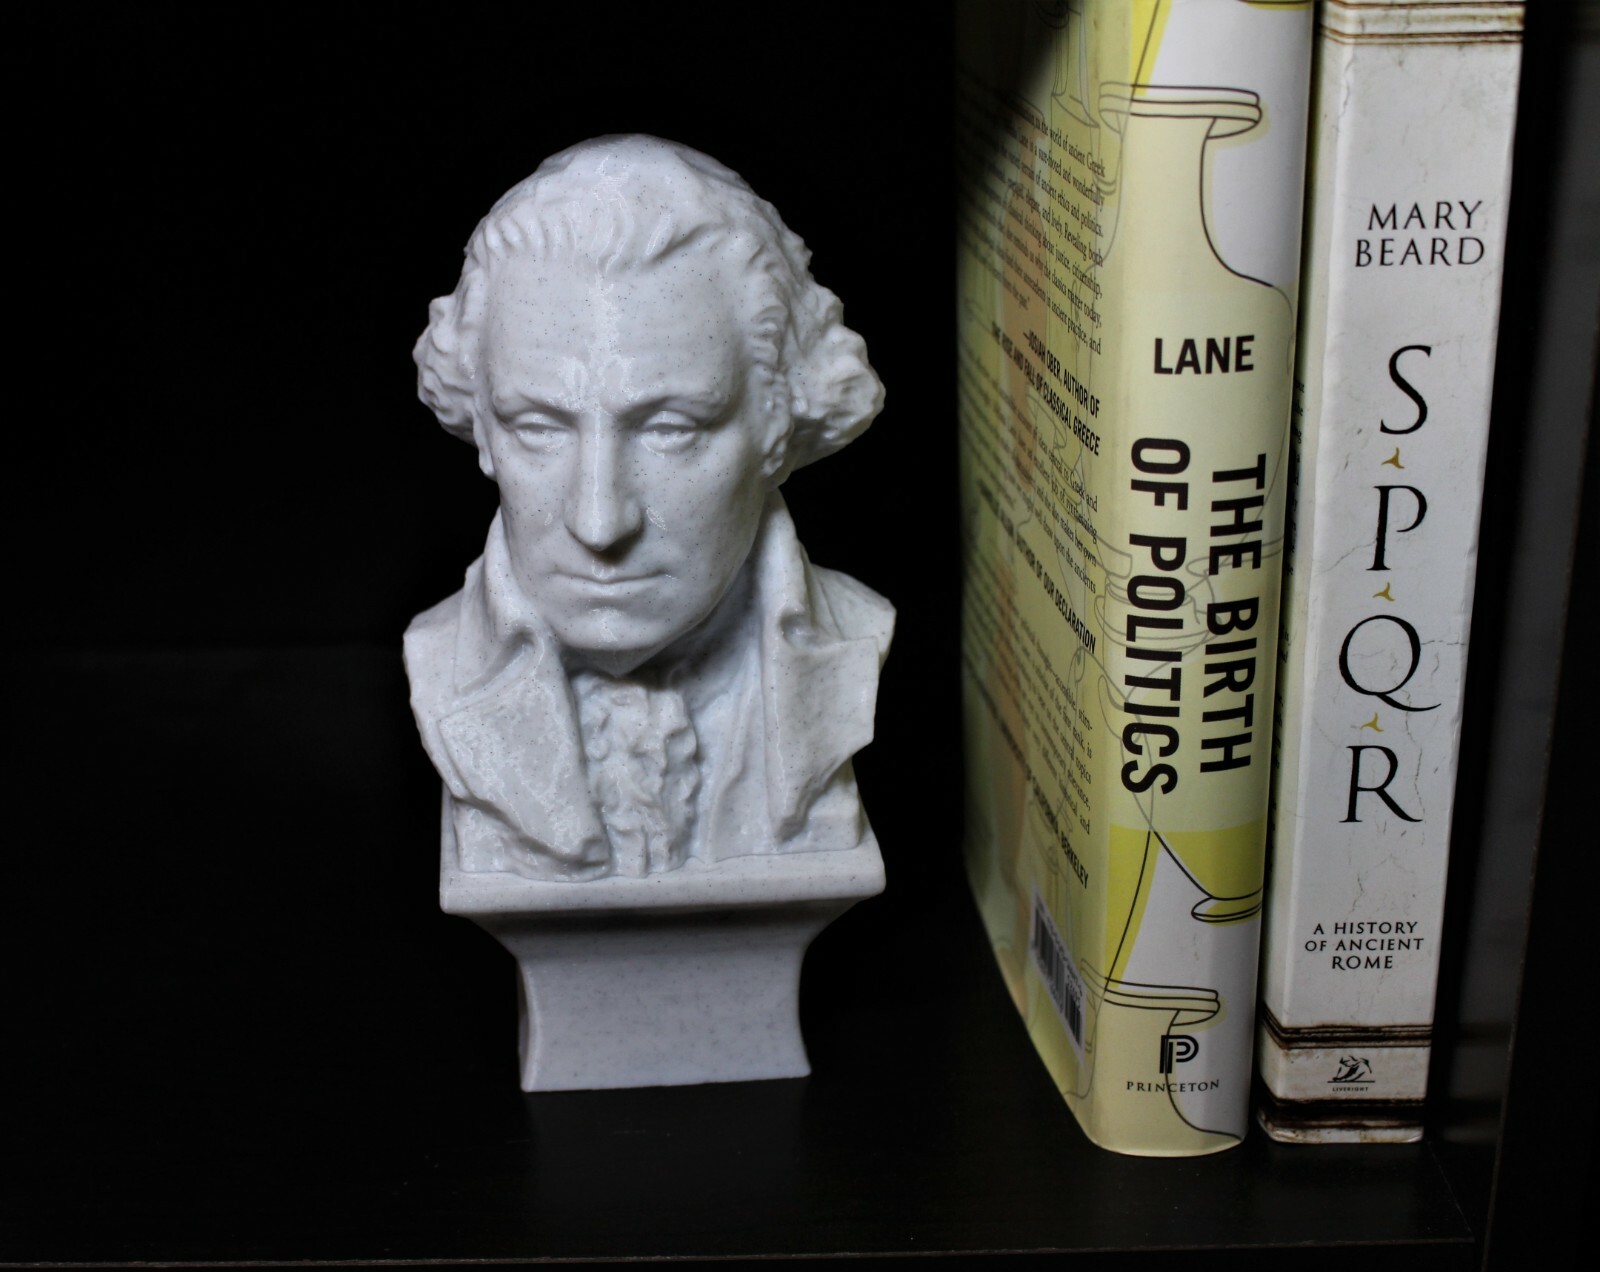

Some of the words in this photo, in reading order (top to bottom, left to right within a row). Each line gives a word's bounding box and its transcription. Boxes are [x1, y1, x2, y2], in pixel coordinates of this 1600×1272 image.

[1038, 148, 1061, 175] sure-footed
[1062, 165, 1071, 184] and
[1072, 176, 1104, 214] wonderfully
[1049, 127, 1061, 147] world
[1062, 135, 1068, 152] of
[1068, 143, 1085, 166] ancient
[1086, 152, 1105, 177] Greek
[1035, 168, 1040, 186] of
[1041, 176, 1056, 201] ancient
[1058, 189, 1070, 212] ethics
[1070, 201, 1079, 220] and
[1080, 208, 1104, 238] politics.
[1368, 200, 1483, 230] MARY
[1042, 204, 1050, 223] and
[1064, 220, 1086, 261] Revealing
[1088, 240, 1103, 267] both
[1356, 237, 1485, 268] BEARD
[1042, 231, 1054, 255] about
[1056, 248, 1071, 274] justice,
[1072, 259, 1102, 302] citizenship,
[1051, 267, 1066, 296] classics
[1067, 288, 1083, 311] matter
[1084, 299, 1102, 328] today,
[1051, 301, 1067, 325] ancient
[1067, 317, 1088, 346] practice,
[1088, 333, 1101, 354] and
[1154, 334, 1255, 375] LANE
[1024, 357, 1034, 386] FALL
[1036, 370, 1043, 396] OF
[1043, 378, 1072, 430] CLASSICAL
[1073, 413, 1100, 458] GREECE
[1046, 348, 1062, 385] OBER,
[1063, 366, 1087, 410] AUTHOR
[1089, 393, 1100, 421] OF
[1063, 464, 1068, 481] to
[1070, 468, 1084, 499] Greek
[1085, 491, 1098, 513] and
[1130, 437, 1191, 511] OF
[1051, 502, 1060, 524] also
[1060, 518, 1074, 543] makes
[1074, 530, 1083, 554] her
[1083, 546, 1096, 567] own
[1059, 487, 1065, 505] of
[1066, 498, 1097, 545] synthesizing
[1208, 453, 1267, 576] THE
[1053, 534, 1065, 558] upon
[1073, 560, 1096, 595] ancients
[1036, 559, 1043, 585] OF
[1043, 570, 1054, 602] OUR
[1054, 586, 1096, 658] DECLARATION
[1120, 533, 1187, 795] POLITICS
[1199, 596, 1260, 773] BIRTH
[1072, 725, 1085, 752] rank,
[1086, 739, 1092, 760] is
[1078, 708, 1093, 735] stim-
[1060, 731, 1074, 762] central
[1075, 752, 1092, 786] topics
[1067, 768, 1090, 812] relevance,
[1079, 814, 1090, 835] and
[1060, 829, 1089, 893] BERKELEY
[1304, 940, 1327, 952] OF
[1335, 938, 1425, 951] ANCIENT
[1313, 923, 1325, 935] A
[1334, 921, 1419, 935] HISTORY
[1331, 955, 1394, 971] ROME
[1126, 1079, 1220, 1093] PRINCETON
